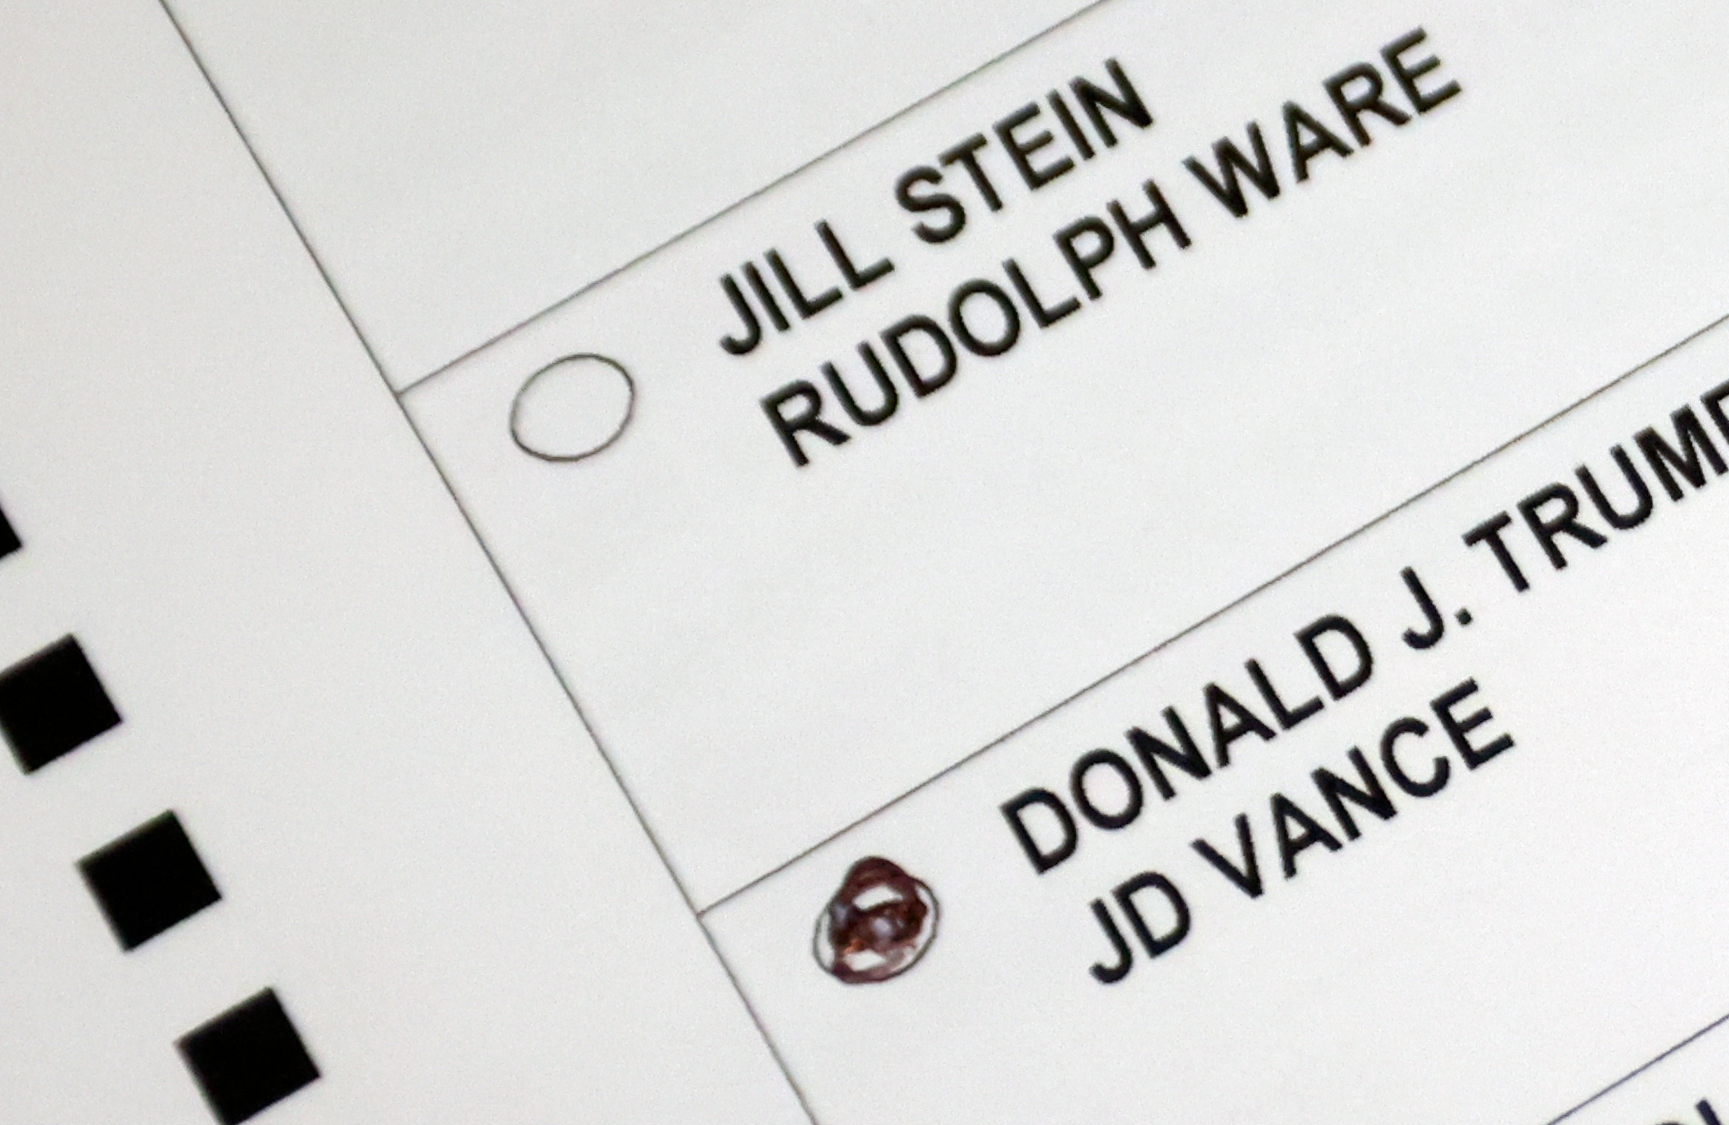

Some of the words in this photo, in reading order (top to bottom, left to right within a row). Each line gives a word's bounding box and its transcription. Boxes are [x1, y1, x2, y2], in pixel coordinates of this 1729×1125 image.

[718, 218, 897, 358] JILL
[893, 57, 1155, 246] STEIN
[759, 178, 1194, 469] RUDOLPH
[1181, 26, 1464, 220] WARE
[998, 613, 1376, 877] DONALD
[1399, 565, 1475, 652] J.
[1088, 870, 1193, 987] JD
[1189, 675, 1517, 901] VANCE
